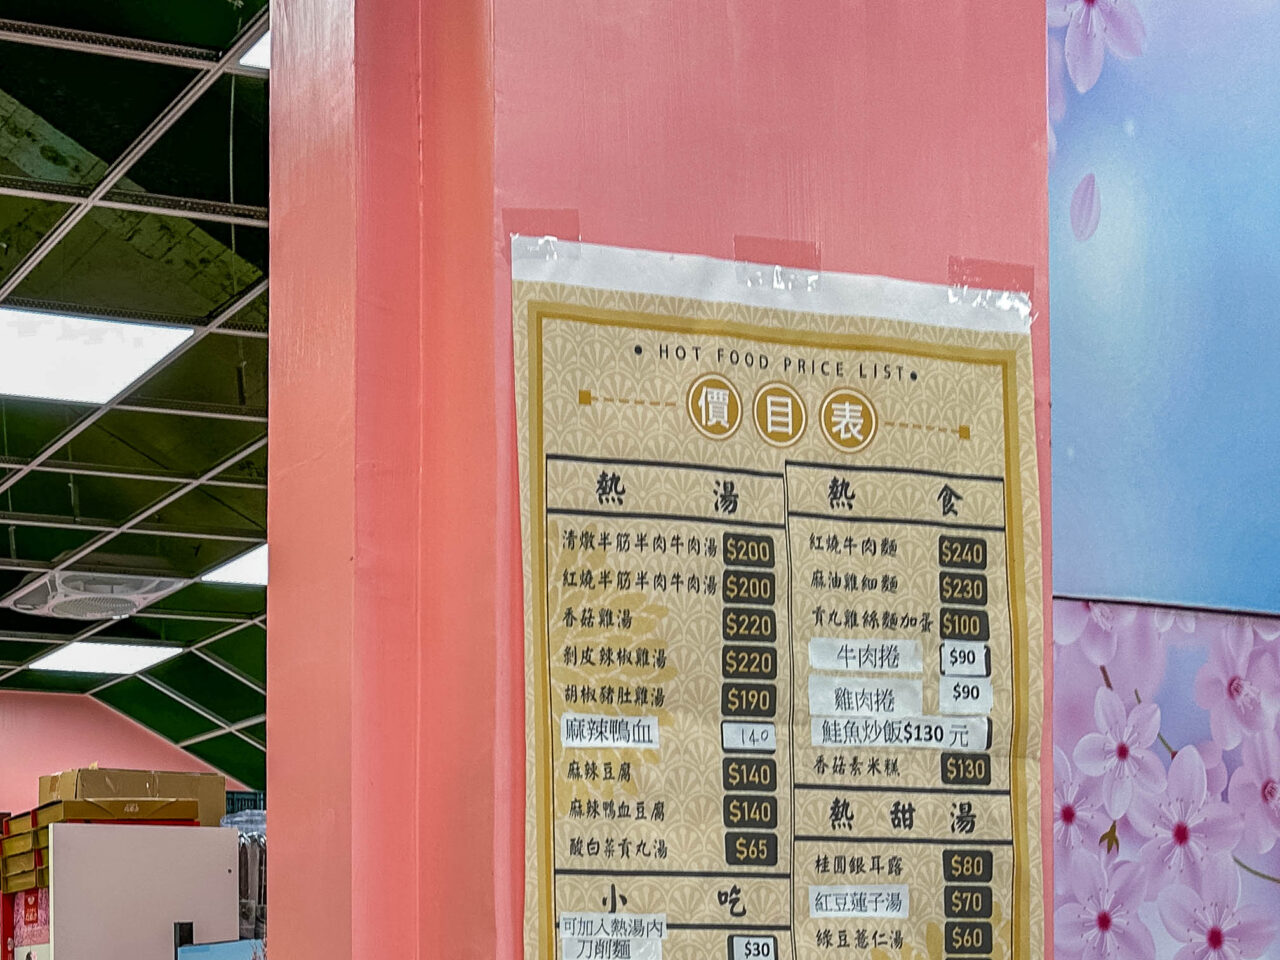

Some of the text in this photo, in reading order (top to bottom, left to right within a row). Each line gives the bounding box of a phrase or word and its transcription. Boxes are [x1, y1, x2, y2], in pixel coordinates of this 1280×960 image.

[659, 343, 905, 382] HOT FOOD PRICE LIST
[697, 384, 865, 441] 價目表
[726, 538, 771, 562] $200
[809, 532, 898, 558] 紅燒牛肉麵
[941, 540, 984, 564] $240
[562, 568, 718, 596] 紅燒半筋半肉牛肉湯
[726, 575, 771, 599] $200
[942, 577, 984, 600] $230
[562, 607, 633, 630] 香菇雞湯
[726, 613, 772, 637] $220
[812, 606, 934, 633] 貢丸雞絲麵加蛋
[943, 612, 981, 636] $100
[725, 650, 772, 674] $220
[949, 647, 976, 666] $90
[564, 684, 665, 708] 胡椒豬肚雞湯
[727, 689, 771, 712] $190
[952, 682, 980, 702] $90
[565, 716, 654, 744] 麻辣鴨血
[567, 761, 632, 783] 麻辣豆腐
[727, 763, 771, 787] $140
[813, 755, 901, 778] 香菇素米糕
[946, 759, 986, 782] $130
[568, 798, 666, 822] 麻辣鴨血豆腐
[729, 800, 772, 824] $140
[569, 836, 669, 860] 酸白菜貢丸湯
[735, 838, 769, 862] $65
[815, 854, 904, 876] 桂圓銀耳露
[951, 855, 984, 877] $80
[815, 890, 903, 914] 紅豆蓮子湯
[951, 892, 983, 913] $70
[563, 916, 664, 938] 可加入熱湯內
[816, 928, 904, 950] 綠豆薏仁湯
[951, 928, 983, 948] $60
[576, 938, 632, 960] 刀削麵
[744, 941, 771, 959] $30
